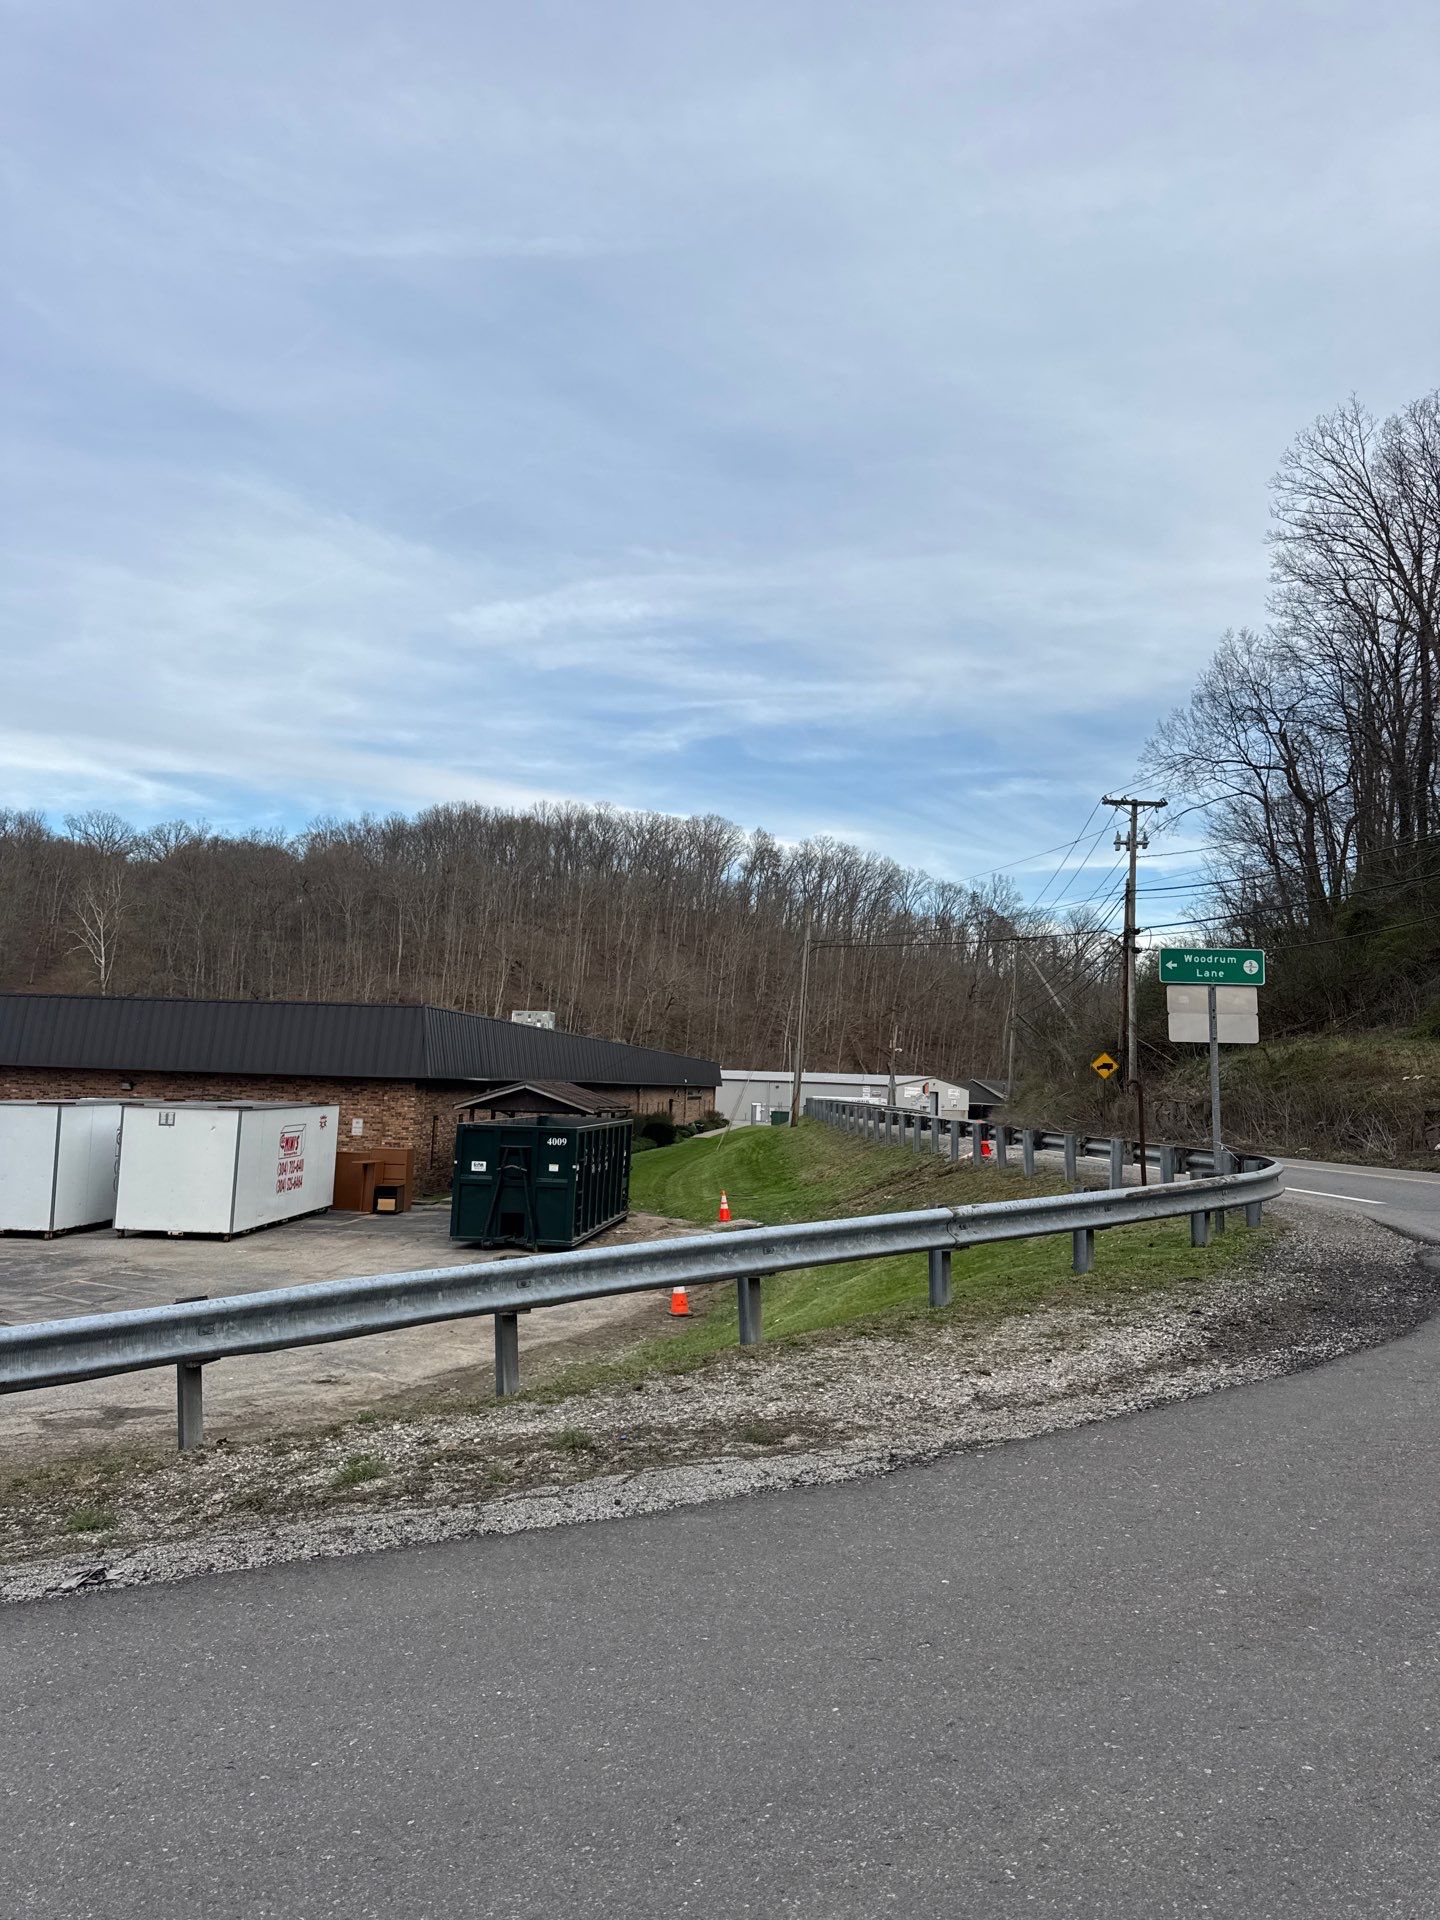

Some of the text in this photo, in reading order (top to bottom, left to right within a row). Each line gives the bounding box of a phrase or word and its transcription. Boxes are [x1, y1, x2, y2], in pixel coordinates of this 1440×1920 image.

[1184, 955, 1237, 964] Woodrum
[1196, 969, 1225, 978] Lane
[547, 1137, 567, 1146] 4009
